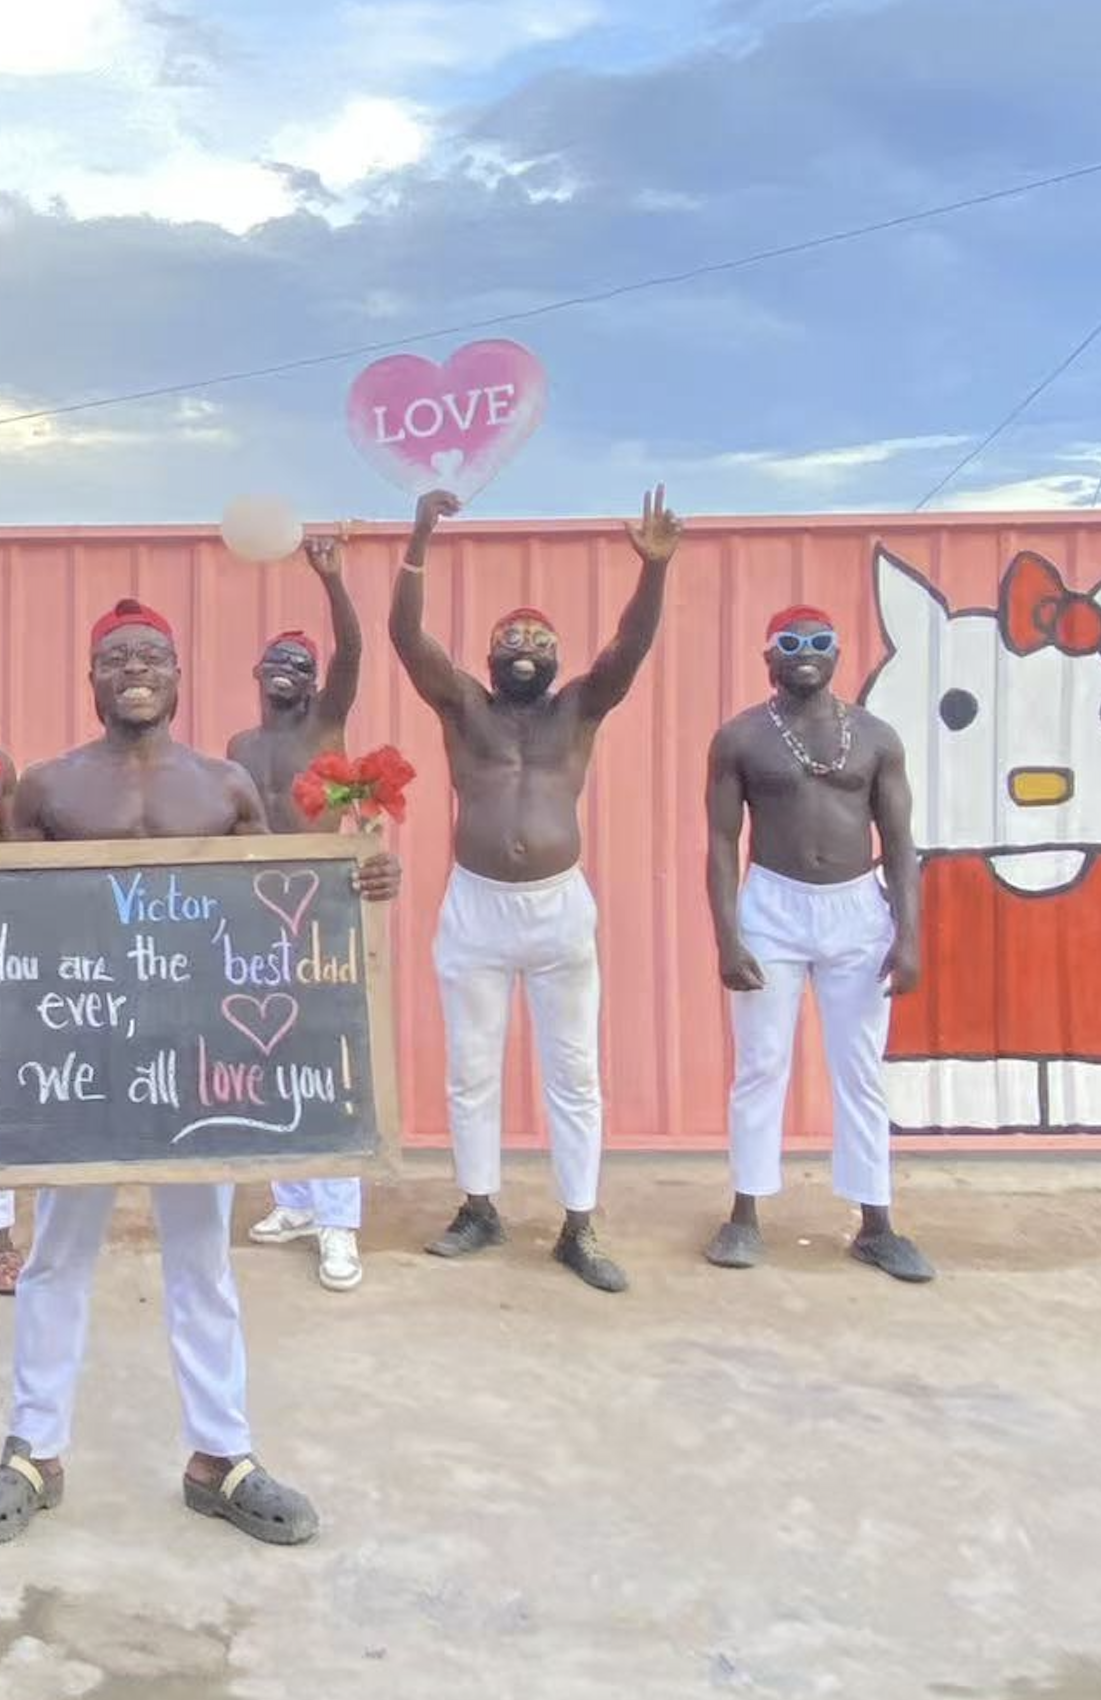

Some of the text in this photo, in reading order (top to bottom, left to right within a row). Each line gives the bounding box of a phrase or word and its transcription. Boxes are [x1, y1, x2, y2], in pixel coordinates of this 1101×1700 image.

[373, 383, 515, 443] LOVE
[107, 872, 227, 943] Victor,
[57, 955, 115, 982] are
[127, 934, 191, 982] the
[222, 926, 292, 986] best
[296, 920, 357, 984] dad
[36, 991, 136, 1039] ever,
[17, 1034, 354, 1132] We all love you!
